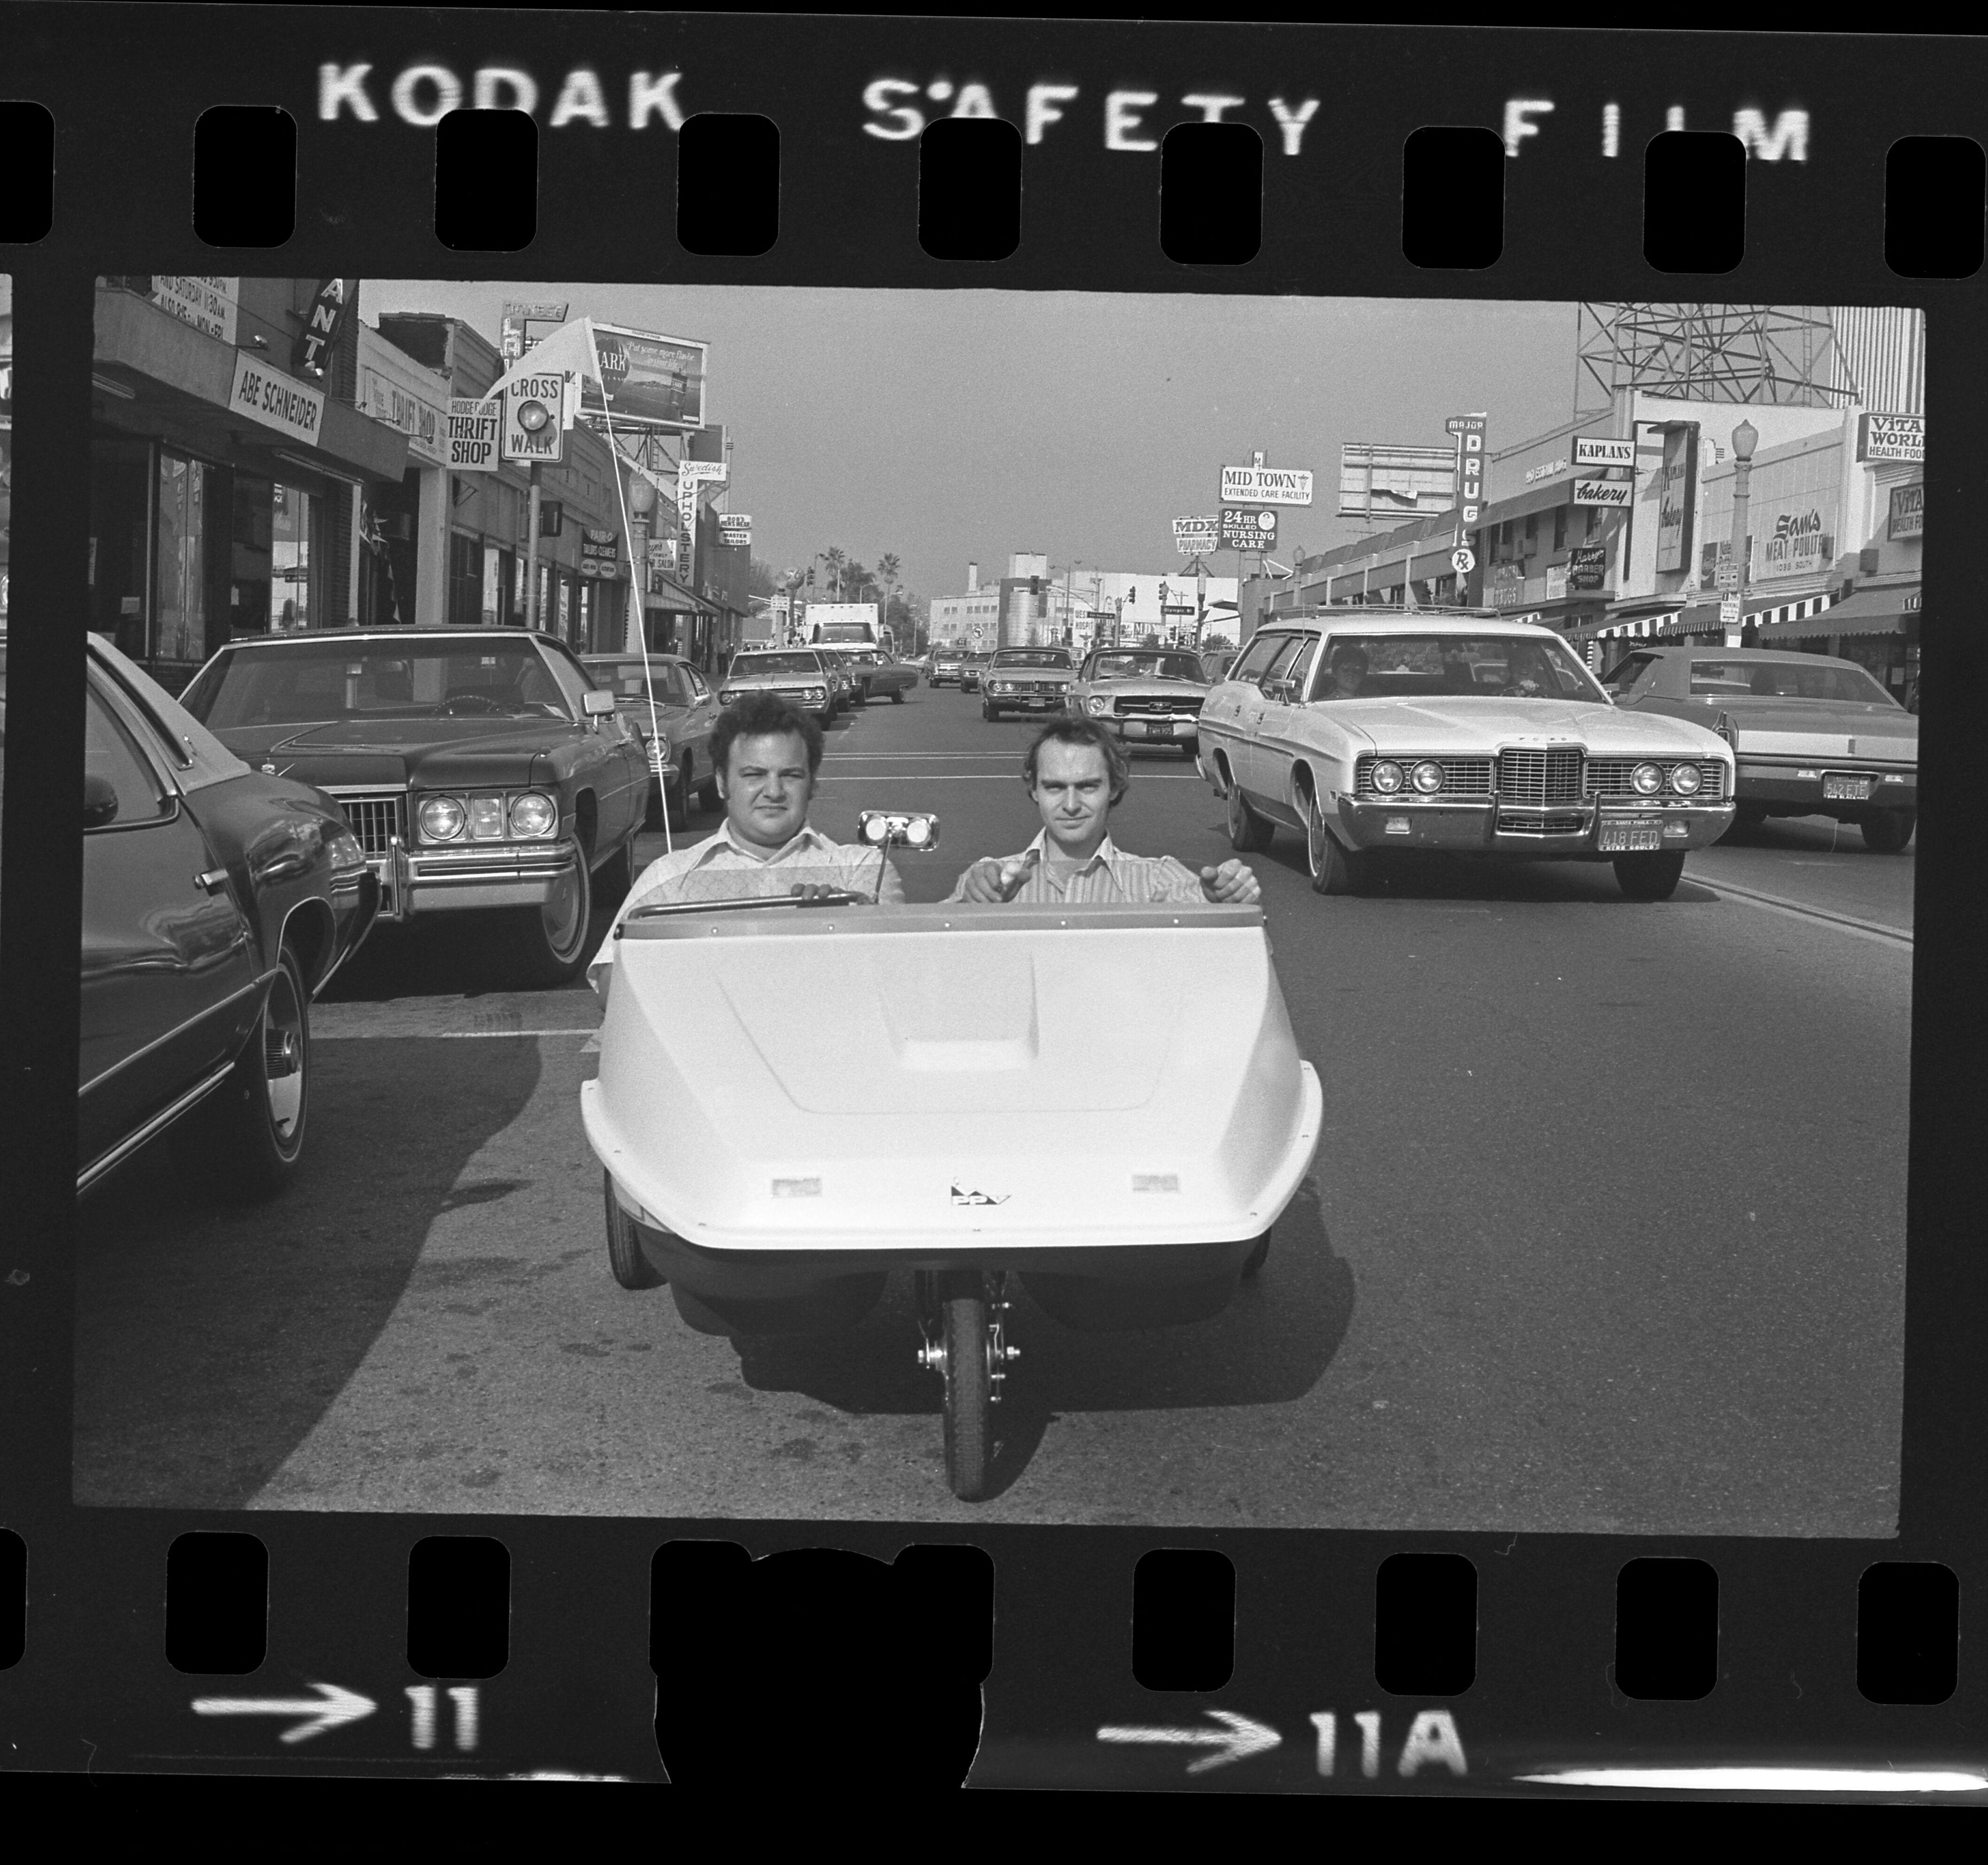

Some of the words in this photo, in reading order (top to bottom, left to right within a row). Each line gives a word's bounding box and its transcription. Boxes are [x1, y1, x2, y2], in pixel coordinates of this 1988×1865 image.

[318, 63, 683, 131] KODAK
[511, 379, 559, 399] CROSS
[239, 370, 262, 406] ABE
[262, 381, 317, 431] SCHNEIDER
[451, 400, 474, 415] HODGE
[447, 416, 498, 441] THRIFT
[1449, 420, 1483, 430] MAJOR
[451, 440, 492, 464] SHOP
[511, 434, 553, 455] WALK
[1579, 444, 1631, 459] KAPLANS
[1869, 446, 1902, 458] HEALTH
[681, 462, 723, 476] Swedish
[1224, 471, 1252, 486] MID
[1257, 472, 1297, 489] TOWN
[1224, 488, 1259, 497] EXTENDED
[1261, 490, 1279, 498] CARE
[1282, 491, 1310, 500] FACILITY
[1576, 482, 1628, 504] bakery
[679, 481, 694, 583] UPHOLSTERY
[1773, 508, 1821, 540] Sam's
[1222, 530, 1276, 540] NURSING
[1232, 540, 1265, 549] CARE
[1765, 540, 1788, 561] MEAT
[1604, 831, 1627, 846] 418
[1630, 831, 1658, 845] FED
[404, 1684, 478, 1750] 11
[1309, 1709, 1468, 1778] 11A
